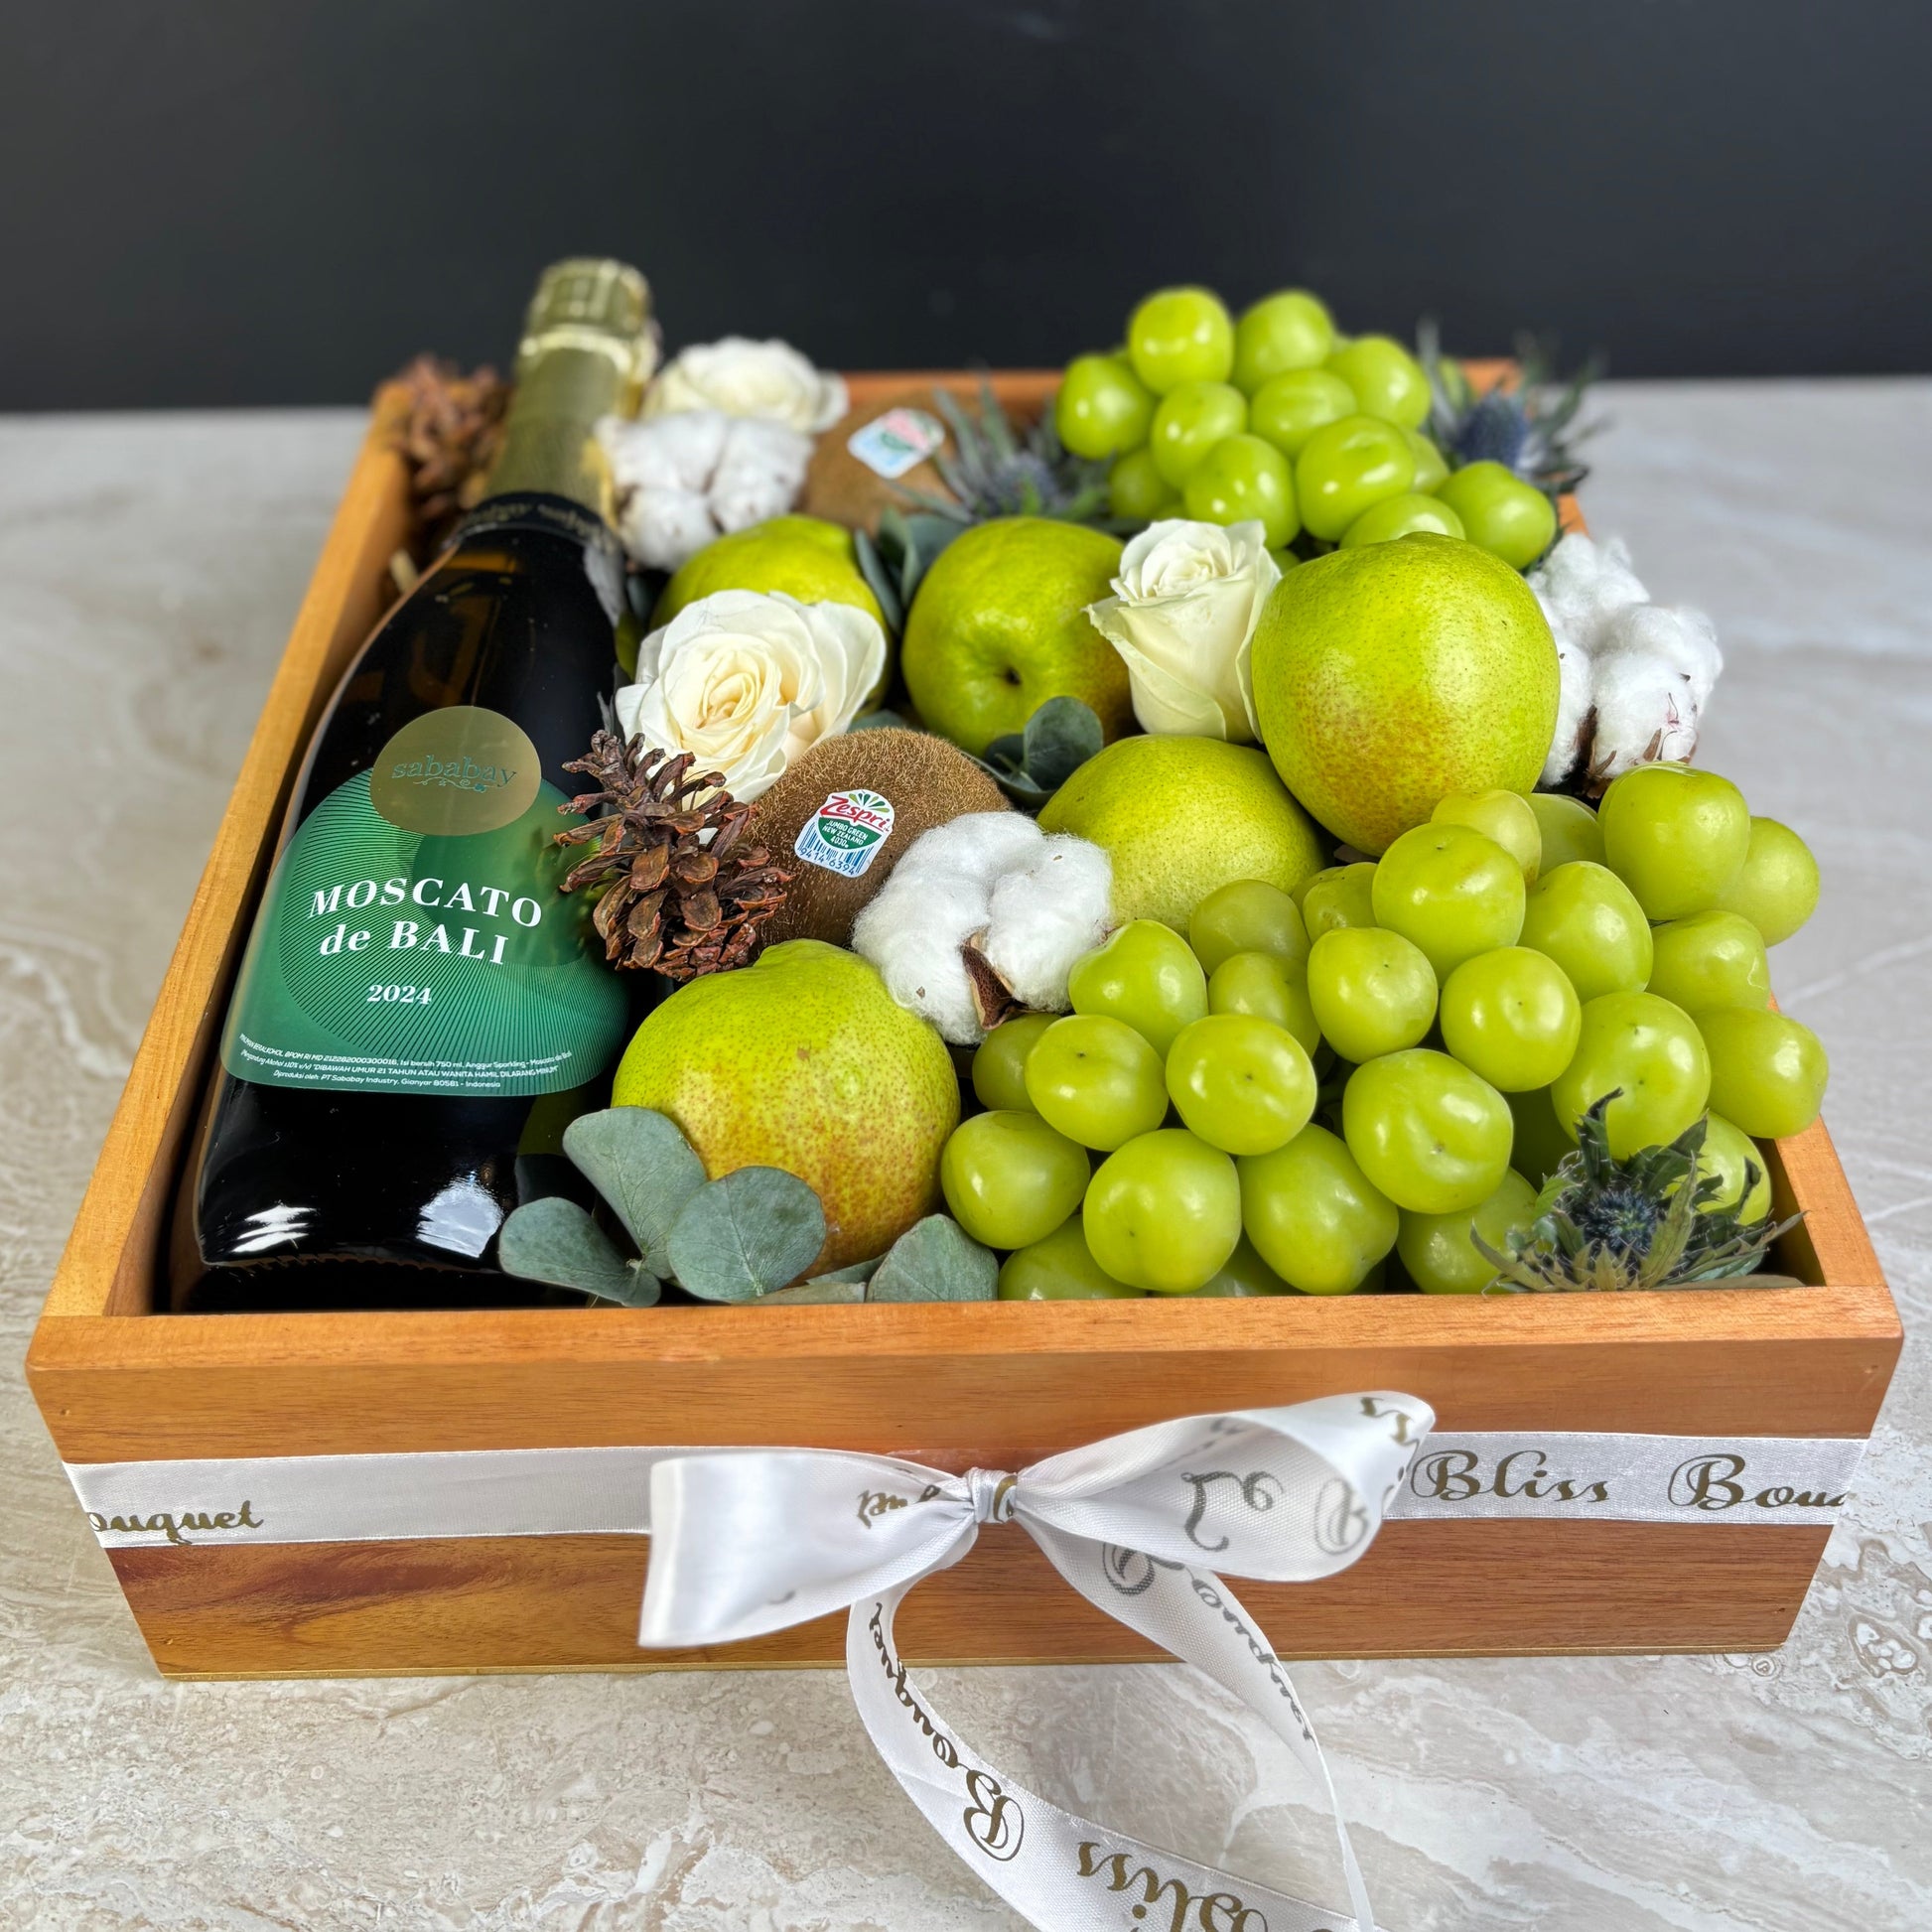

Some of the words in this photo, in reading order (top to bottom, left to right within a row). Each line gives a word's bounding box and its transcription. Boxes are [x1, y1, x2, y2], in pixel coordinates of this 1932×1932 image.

[391, 755, 516, 787] sababay
[820, 795, 890, 829] Zespri
[822, 825, 837, 835] NEW
[837, 831, 864, 845] ZEALAND
[826, 820, 848, 832] JUMBO
[847, 827, 869, 841] GREEN
[800, 847, 824, 863] 9414
[829, 858, 855, 875] 6394
[308, 879, 542, 927] MOSCATO
[320, 924, 370, 956] de
[388, 920, 508, 965] BALI
[367, 984, 432, 1005] 2024
[331, 1074, 365, 1084] Sababay
[400, 1078, 432, 1087] Gianyar
[499, 1068, 537, 1078] DILARANG
[1411, 1449, 1610, 1503] Bliss
[86, 1500, 264, 1545] ouquet
